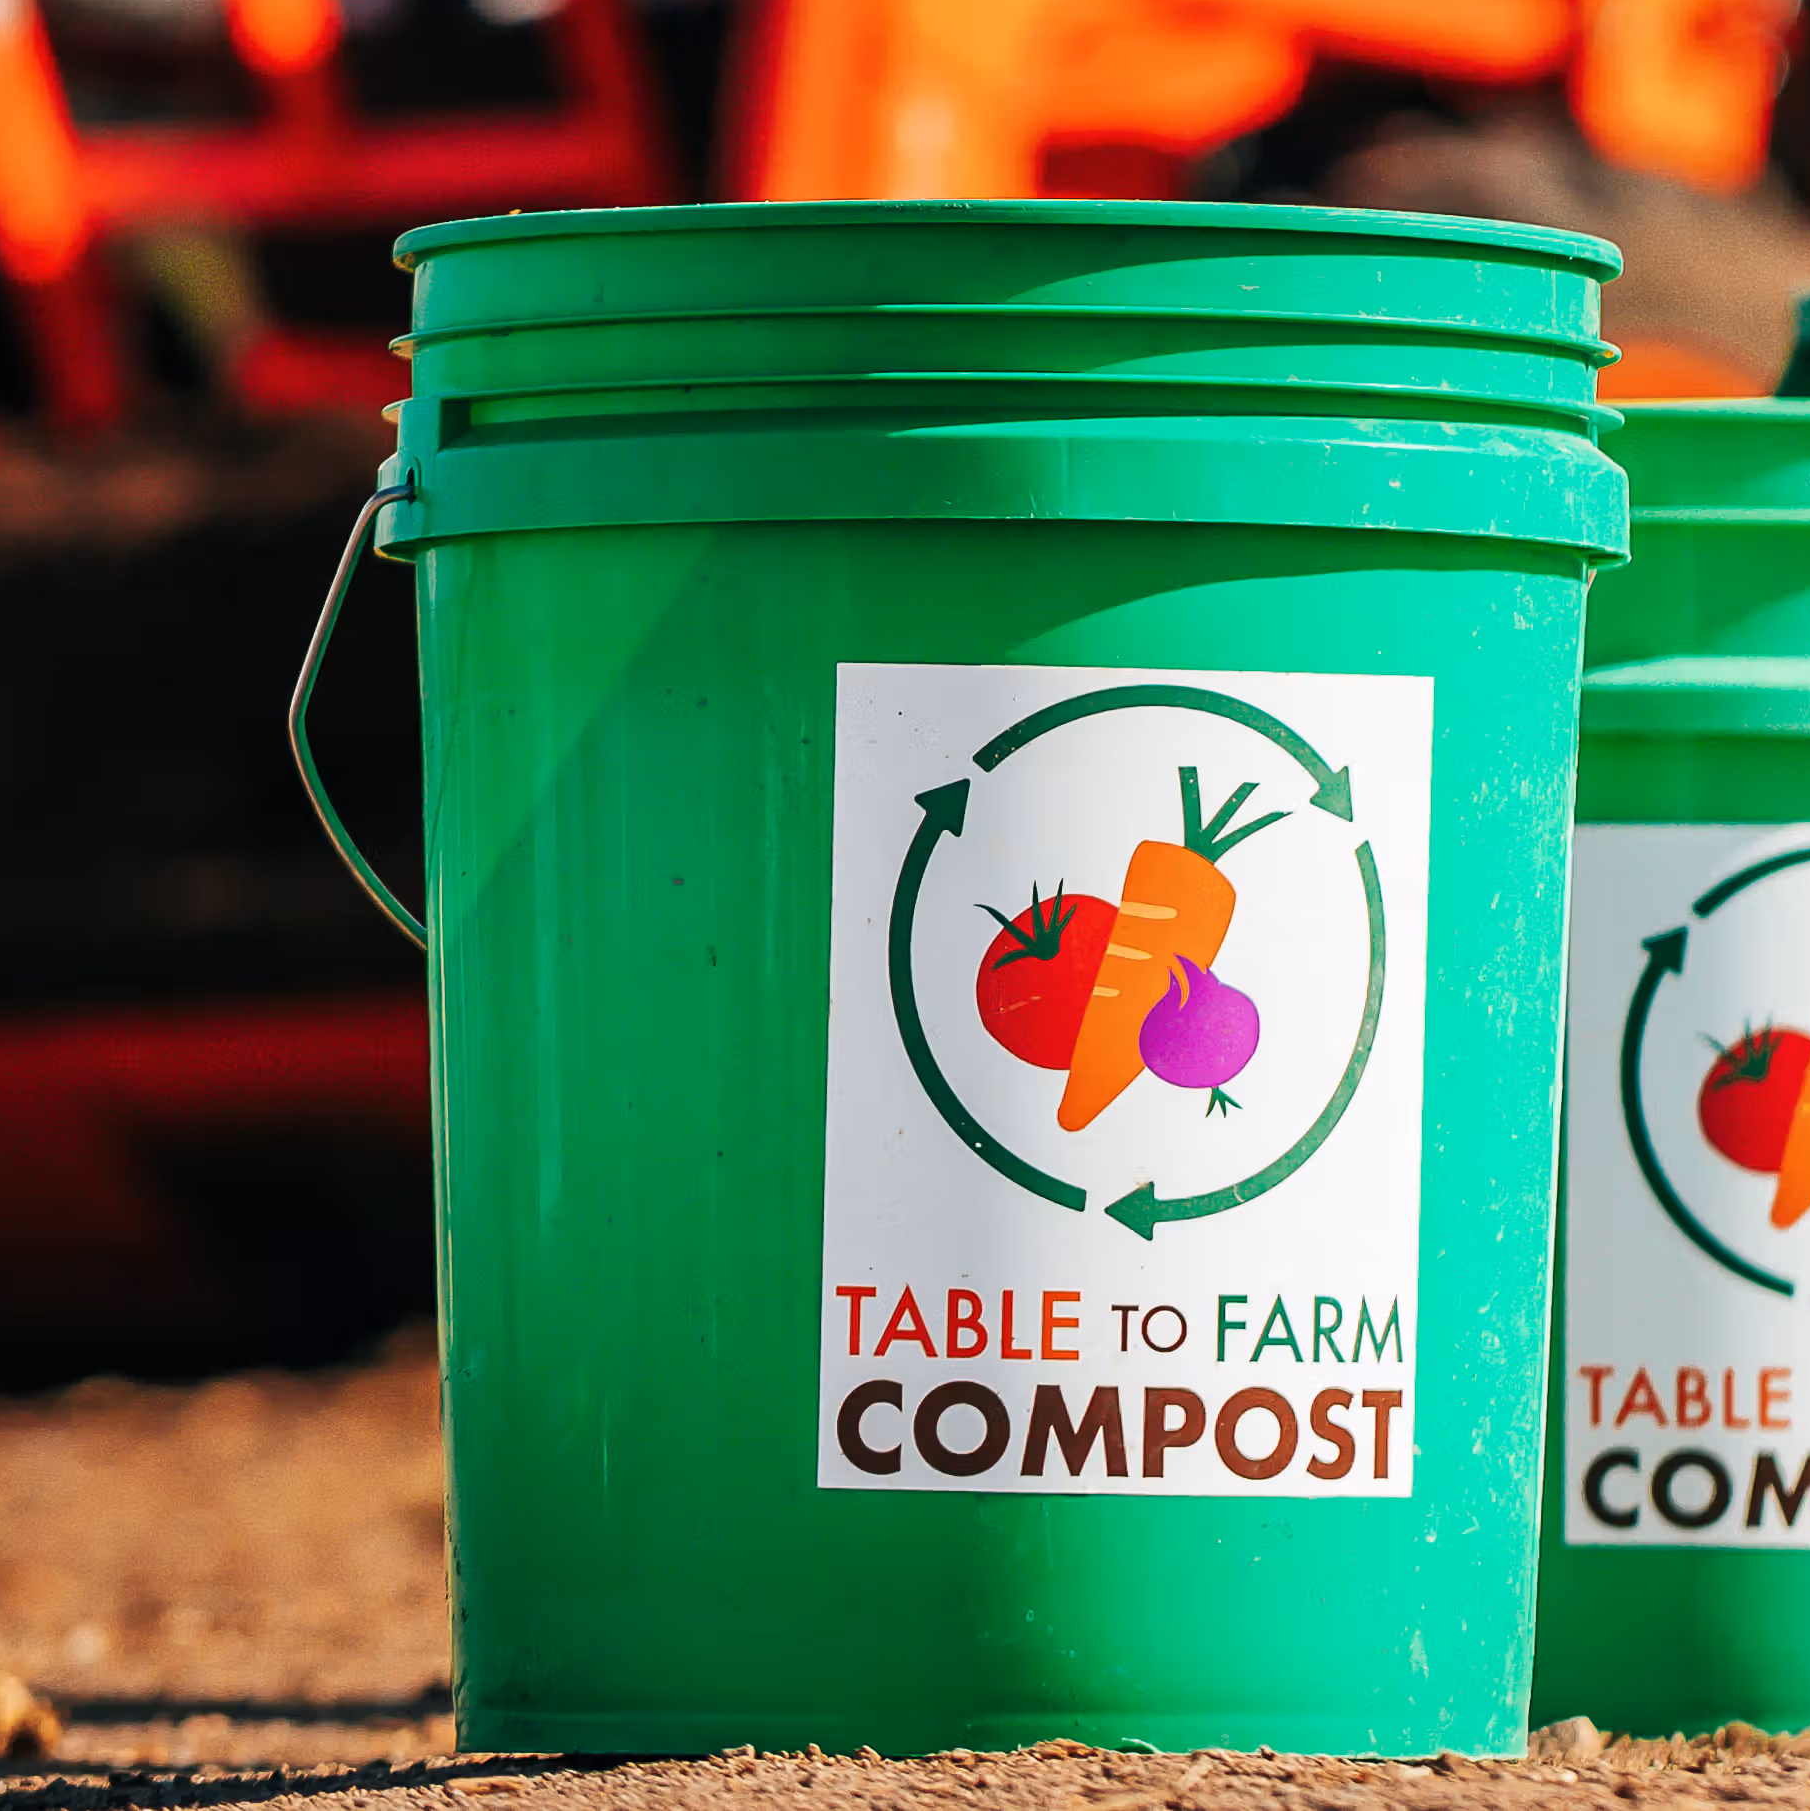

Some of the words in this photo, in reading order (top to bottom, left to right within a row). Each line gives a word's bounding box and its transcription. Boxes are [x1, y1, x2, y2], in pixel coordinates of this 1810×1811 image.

[835, 1283, 1081, 1360] TABLE
[1111, 1305, 1187, 1353] TO
[1216, 1293, 1404, 1363] FARM
[836, 1379, 1404, 1480] COMPOST
[1580, 1365, 1793, 1429] TABLE
